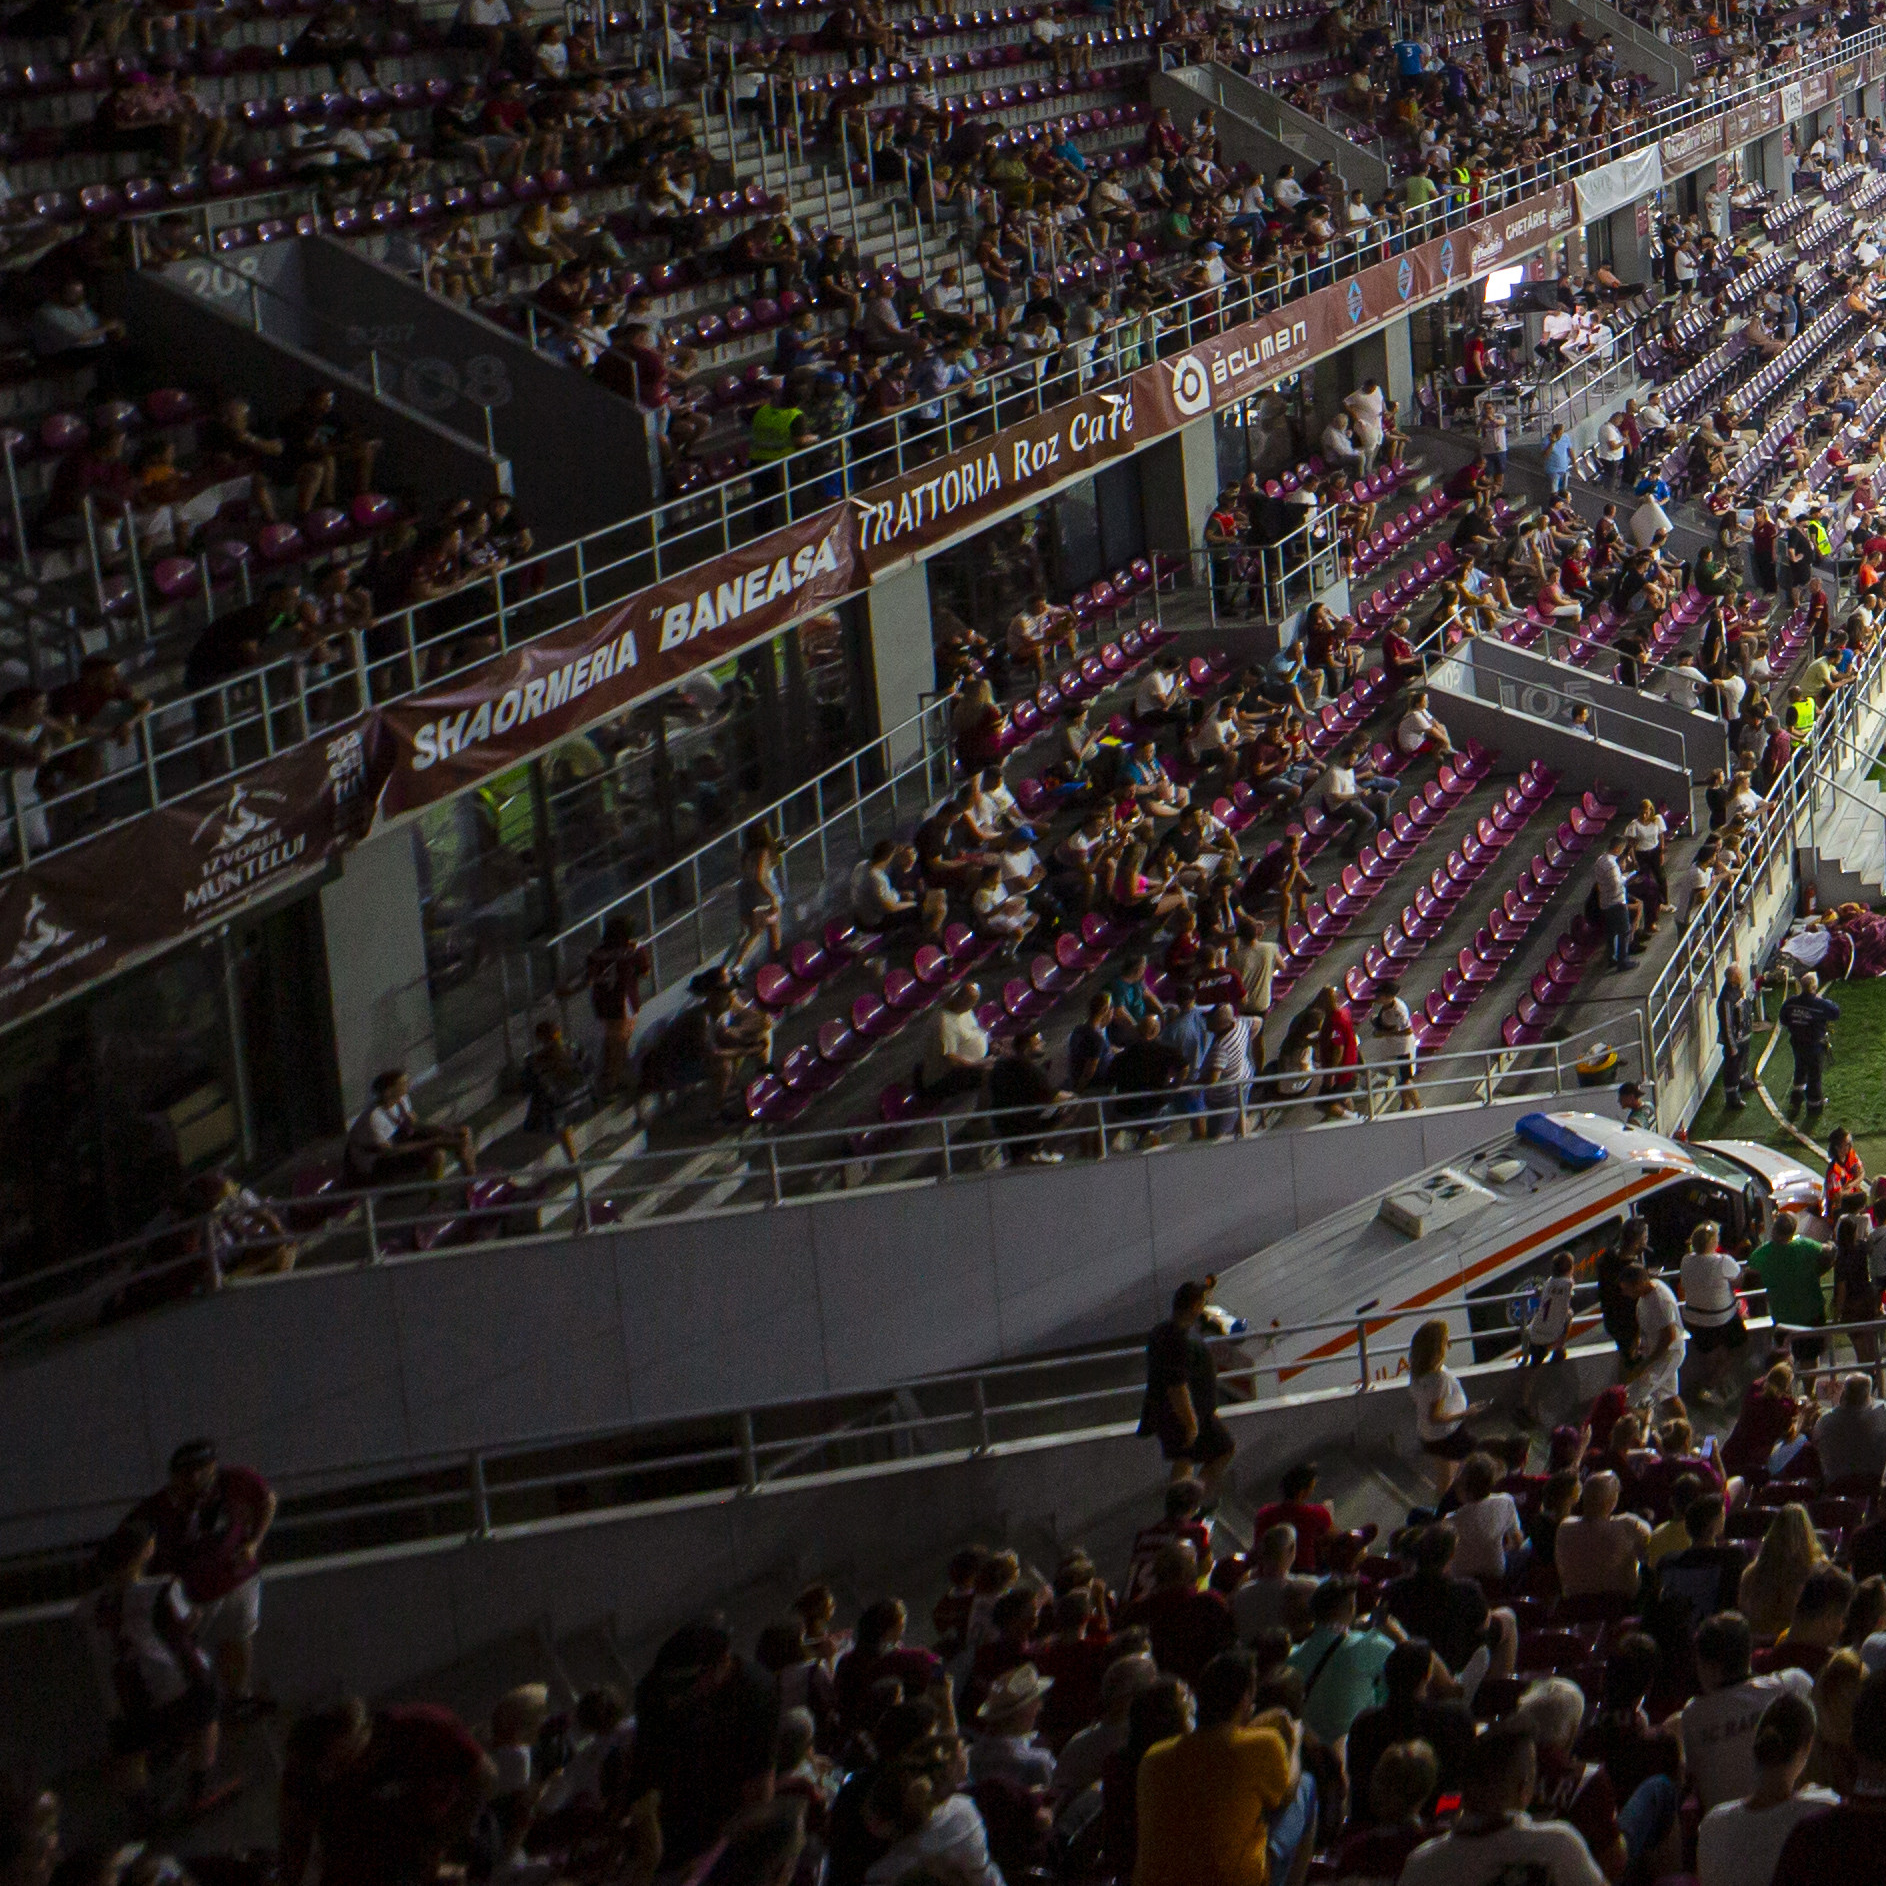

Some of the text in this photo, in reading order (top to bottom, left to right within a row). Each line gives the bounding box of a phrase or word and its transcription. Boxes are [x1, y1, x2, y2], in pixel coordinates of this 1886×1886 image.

[1212, 319, 1308, 385] ácumen
[858, 391, 1135, 552] TRATTORIA Roz Café
[411, 630, 641, 772] SHAORMERIA
[1502, 679, 1595, 722] 105
[183, 832, 308, 915] MUNTELUI
[201, 828, 283, 878] IZVORUL
